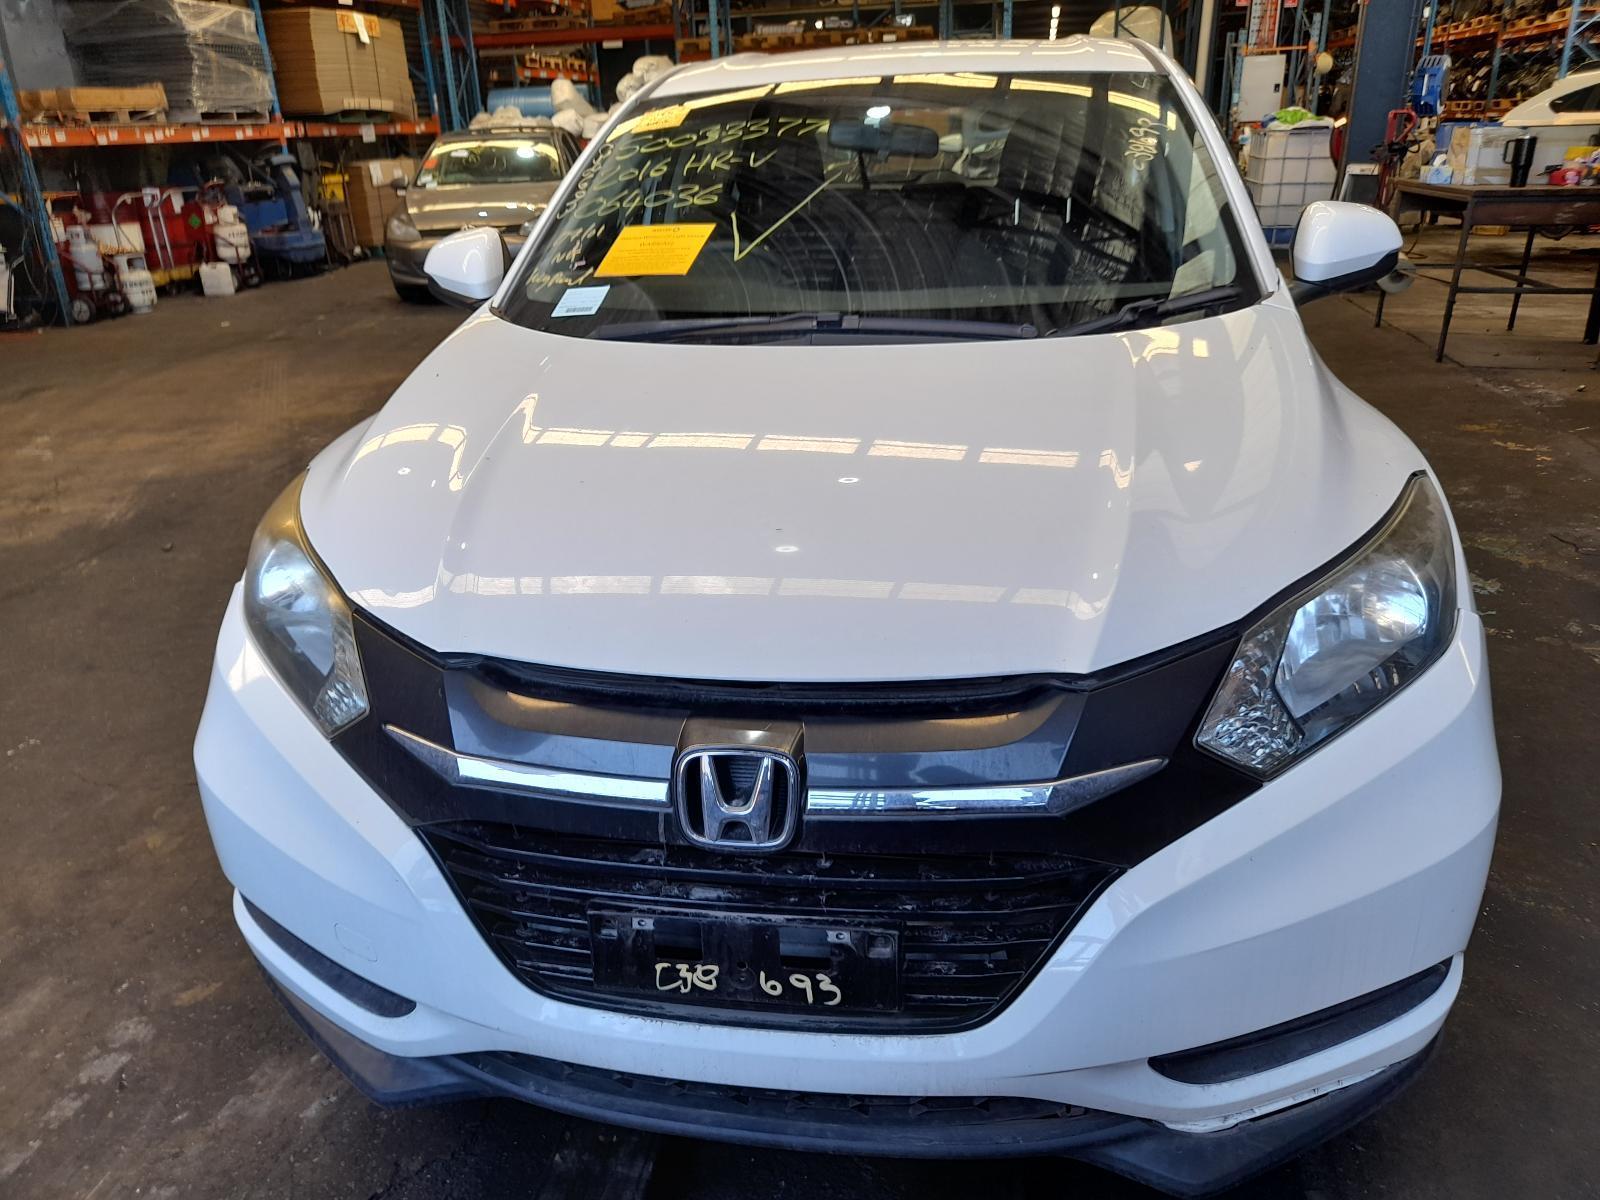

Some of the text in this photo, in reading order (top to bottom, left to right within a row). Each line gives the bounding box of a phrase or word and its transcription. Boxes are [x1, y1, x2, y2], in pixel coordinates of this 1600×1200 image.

[593, 148, 778, 191] 2016 HR-V
[654, 962, 842, 1006] C38 693
